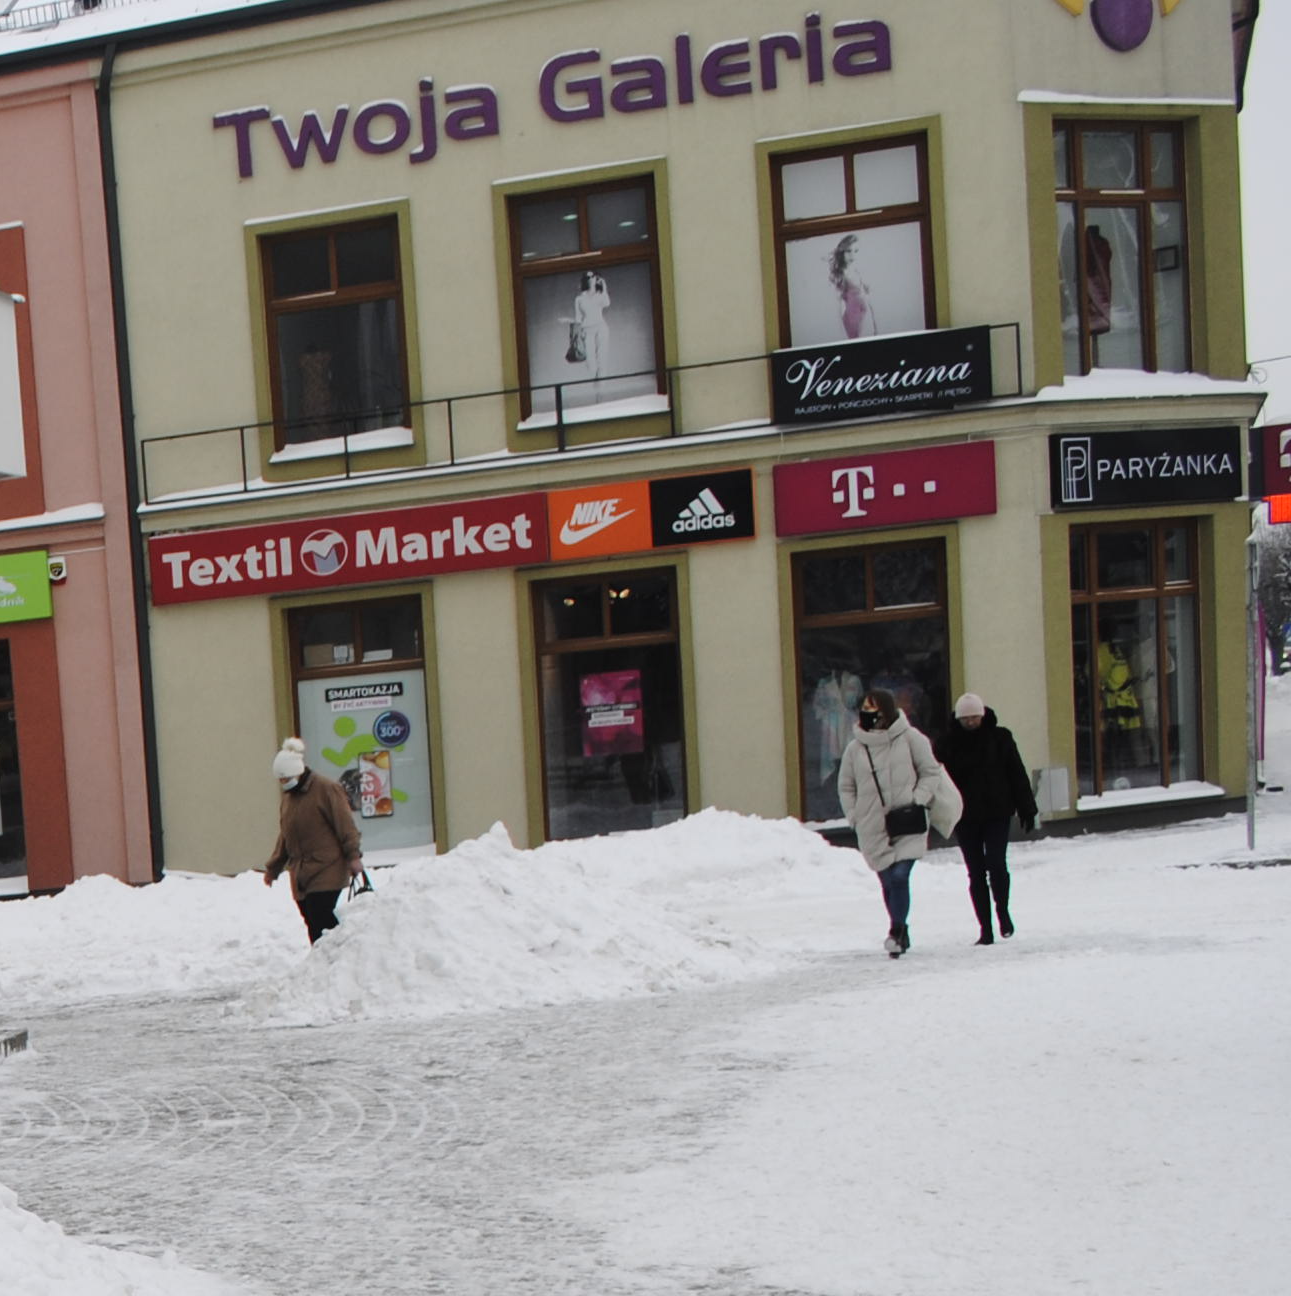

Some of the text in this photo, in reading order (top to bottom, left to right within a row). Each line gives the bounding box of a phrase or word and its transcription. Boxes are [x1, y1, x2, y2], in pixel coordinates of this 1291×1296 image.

[212, 12, 893, 179] Twoja Galeria
[785, 355, 973, 401] Veneziana
[1096, 452, 1235, 481] PARYŻANKA
[569, 498, 622, 526] NIKE
[672, 514, 736, 533] adidas
[162, 513, 532, 589] Textil Market
[327, 684, 400, 700] SMARTOKAZJA
